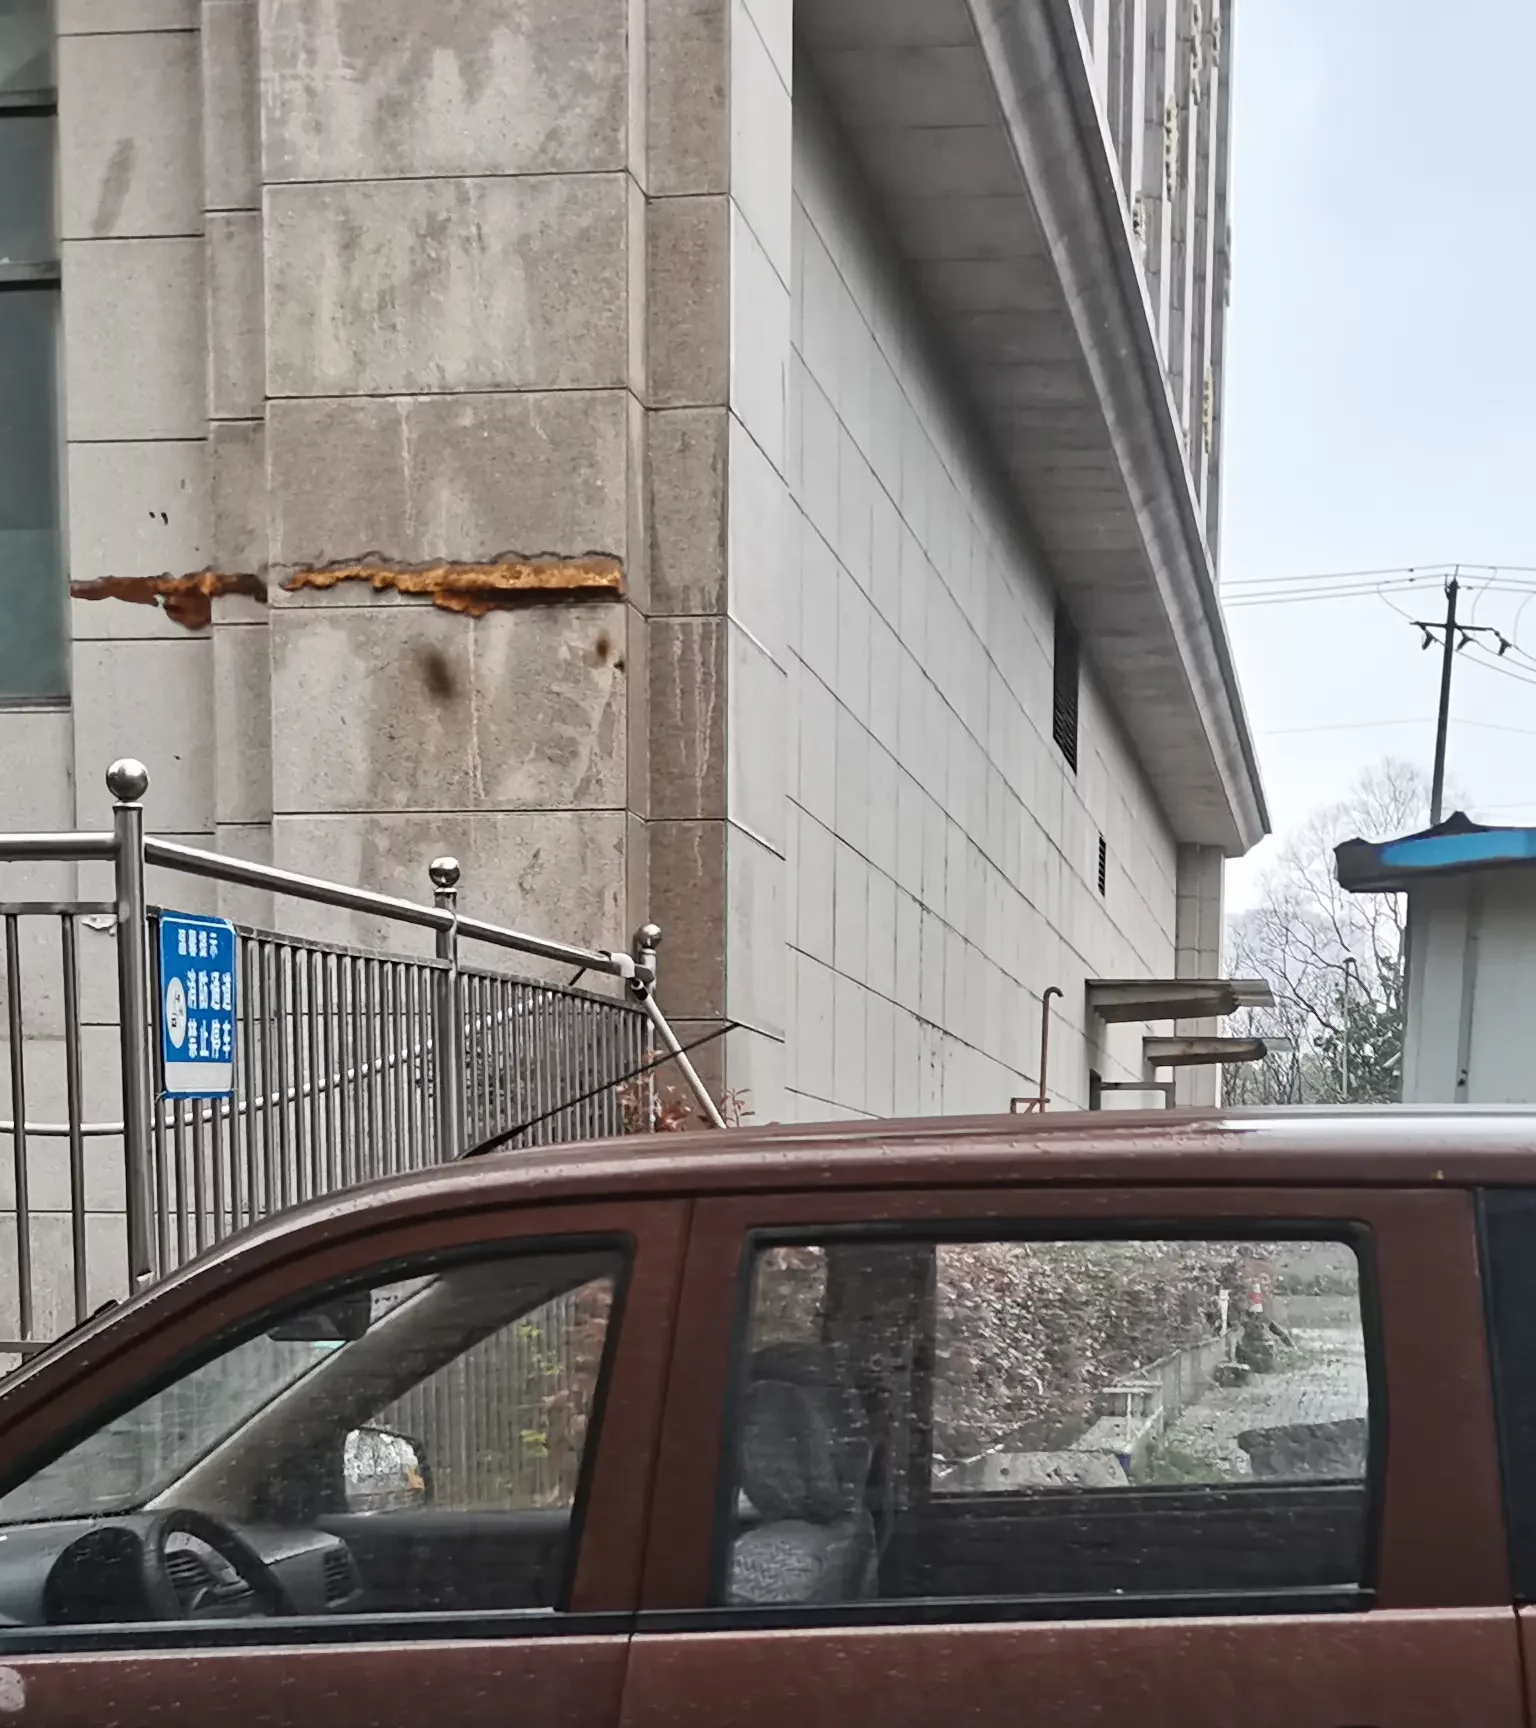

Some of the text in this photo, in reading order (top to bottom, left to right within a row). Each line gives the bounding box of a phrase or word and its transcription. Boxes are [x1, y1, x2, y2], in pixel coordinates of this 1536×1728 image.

[178, 928, 218, 959] 温馨提示
[186, 967, 232, 1011] 消防通道
[187, 1017, 233, 1060] 禁止停车
